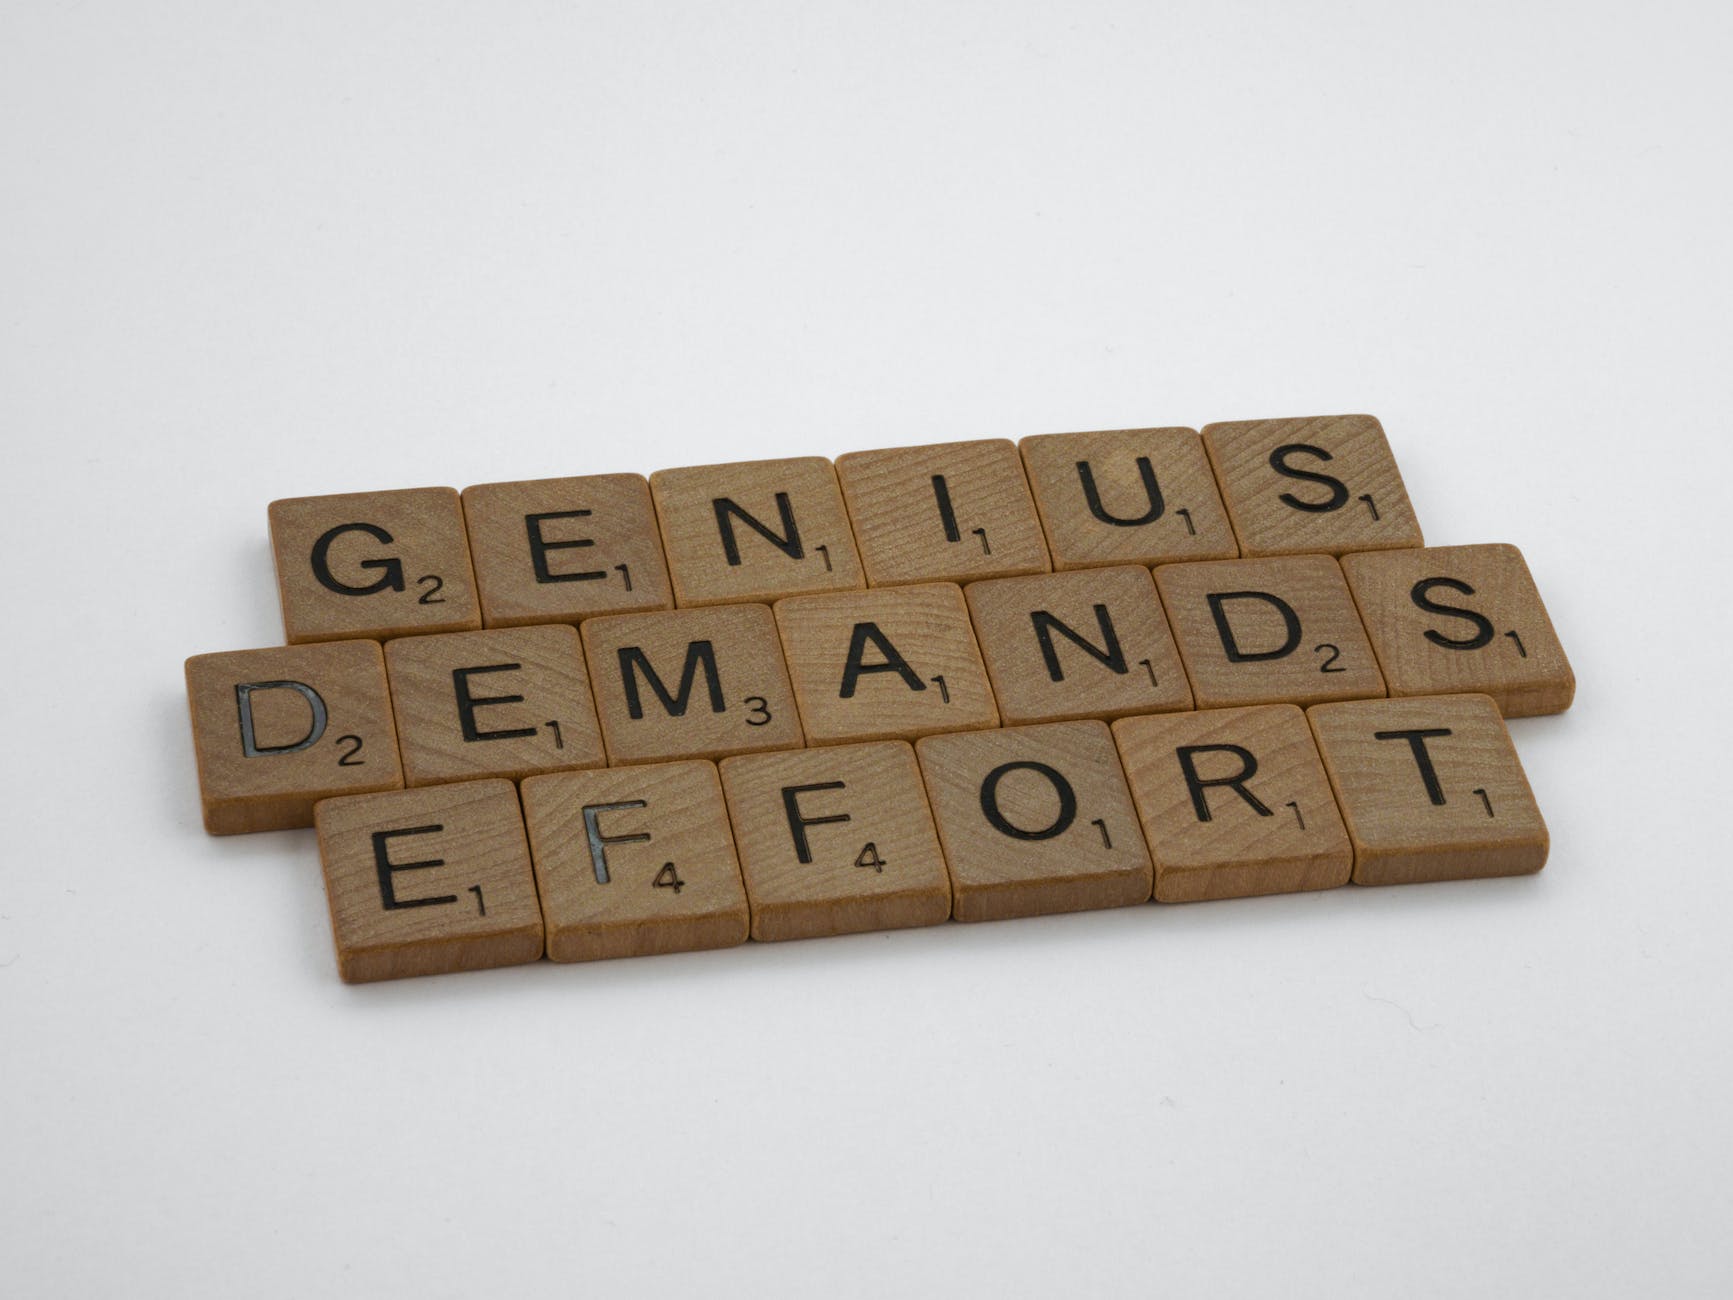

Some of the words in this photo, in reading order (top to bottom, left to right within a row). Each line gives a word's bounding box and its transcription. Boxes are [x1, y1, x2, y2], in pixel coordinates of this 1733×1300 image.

[309, 442, 1350, 597] GENIUS
[1175, 507, 1197, 536] 1
[1357, 493, 1380, 522] 1
[971, 527, 992, 556] 1
[815, 544, 833, 572] 1
[416, 574, 447, 606] 2
[613, 563, 633, 592] 1
[1313, 643, 1347, 674] 2
[1503, 630, 1527, 659] 1
[233, 576, 1496, 759] DEMANDS
[1138, 658, 1158, 688] 1
[930, 674, 950, 704] 1
[743, 695, 773, 727] 3
[544, 719, 564, 750] 1
[334, 734, 366, 767] 2
[1285, 801, 1306, 831] 1
[1472, 788, 1495, 818] 1
[370, 728, 1453, 912] EFFORT
[1090, 818, 1113, 850] 1
[853, 841, 887, 874] 4
[651, 861, 686, 894] 4
[467, 884, 486, 917] 1
